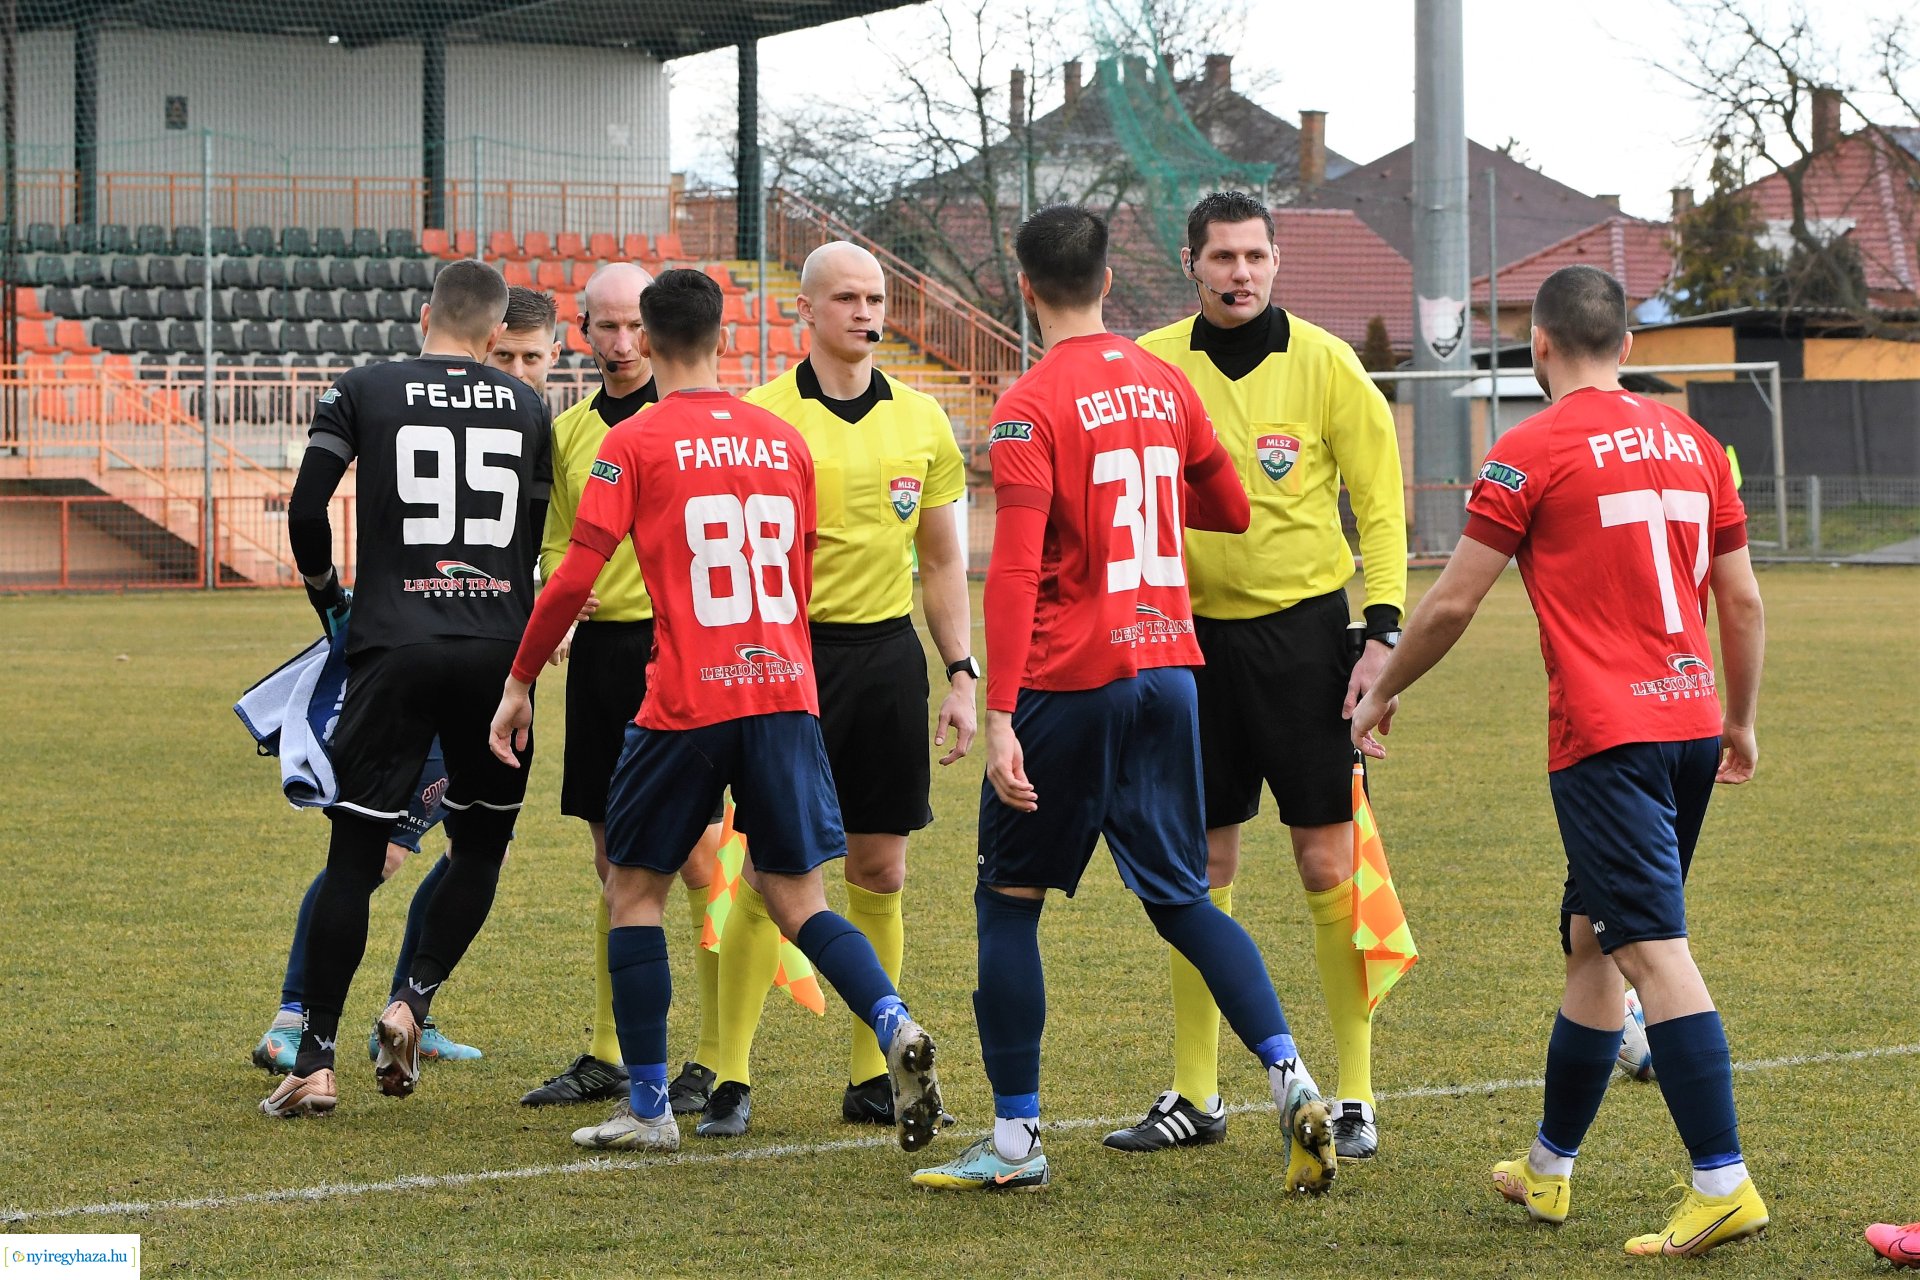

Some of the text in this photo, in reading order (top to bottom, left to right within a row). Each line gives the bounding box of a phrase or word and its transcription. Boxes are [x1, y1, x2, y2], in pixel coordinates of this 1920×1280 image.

[405, 380, 517, 412] FEJÉR
[1074, 384, 1178, 431] DEUTSCH
[674, 435, 791, 472] FARKAS
[1266, 438, 1292, 448] MLSZ
[1587, 421, 1704, 469] PEKÁR
[395, 424, 523, 549] 95
[897, 480, 917, 489] MLSZ
[1092, 445, 1186, 594] 30
[684, 493, 798, 628] 88
[1597, 488, 1710, 635] 77
[765, 660, 805, 675] TRAS
[1630, 673, 1699, 697] LERTON
